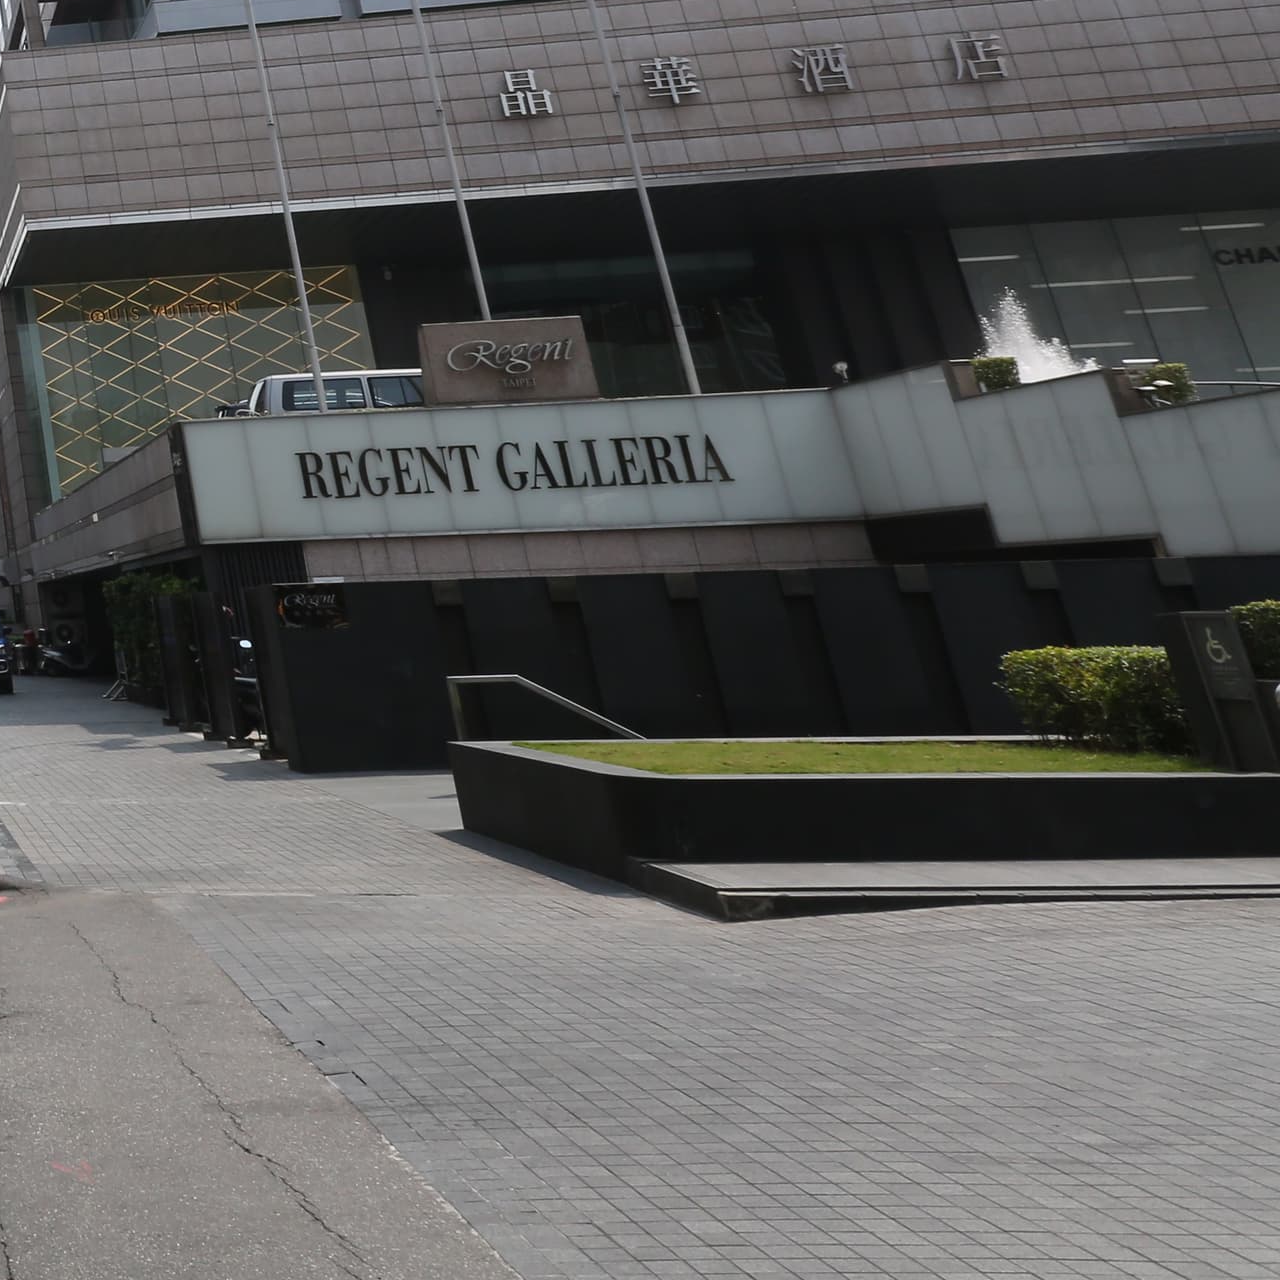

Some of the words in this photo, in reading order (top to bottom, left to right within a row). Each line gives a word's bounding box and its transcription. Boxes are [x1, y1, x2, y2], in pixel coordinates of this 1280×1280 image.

[500, 31, 1009, 118] 晶華酒店
[1215, 246, 1280, 266] CHA
[83, 306, 140, 323] OUIS
[447, 338, 573, 374] Regent
[293, 445, 481, 499] REGENT
[496, 433, 736, 492] GALLERIA
